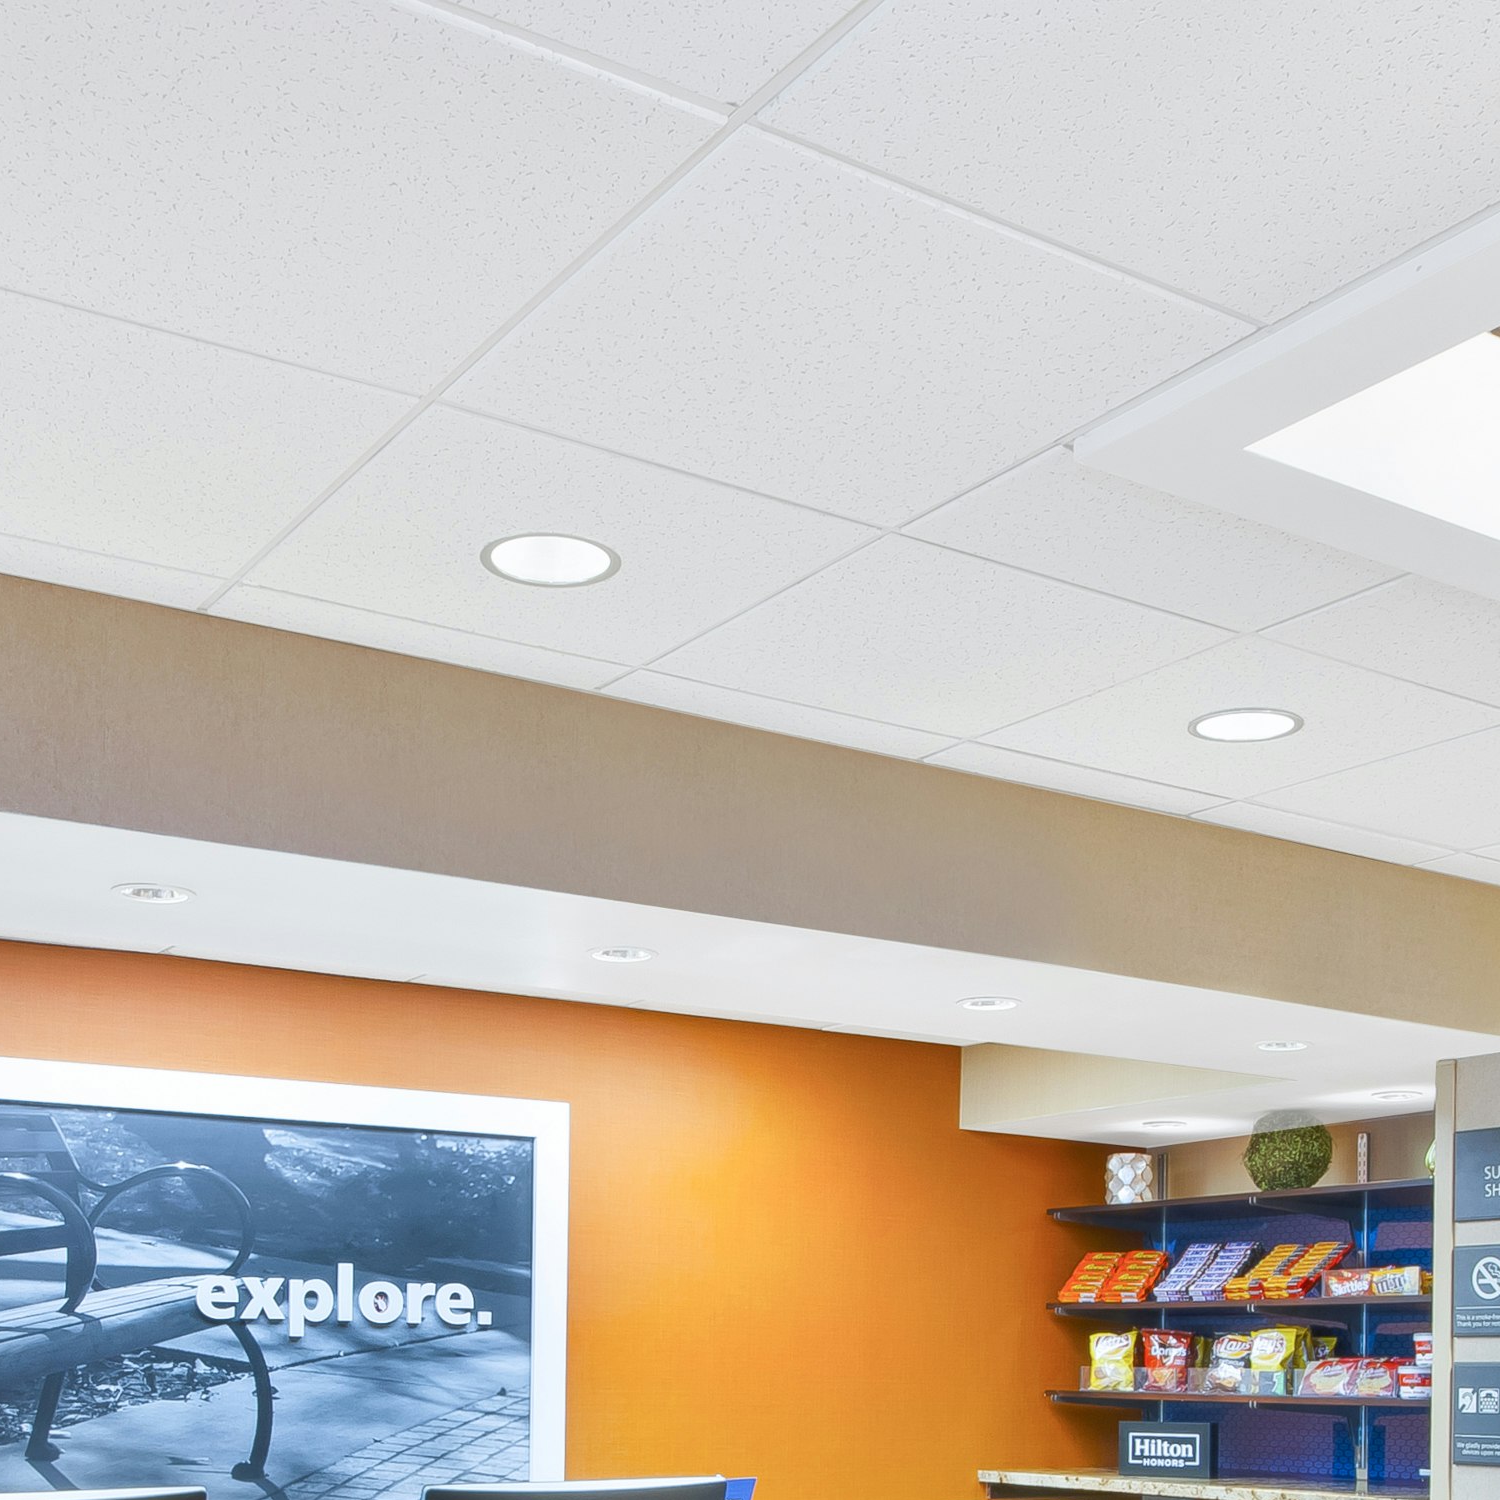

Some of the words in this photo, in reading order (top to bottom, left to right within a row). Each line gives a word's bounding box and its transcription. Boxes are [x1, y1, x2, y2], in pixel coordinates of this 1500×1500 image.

[196, 1262, 492, 1338] explore.
[1134, 1438, 1193, 1457] Hilton
[1143, 1458, 1185, 1467] HONORS
